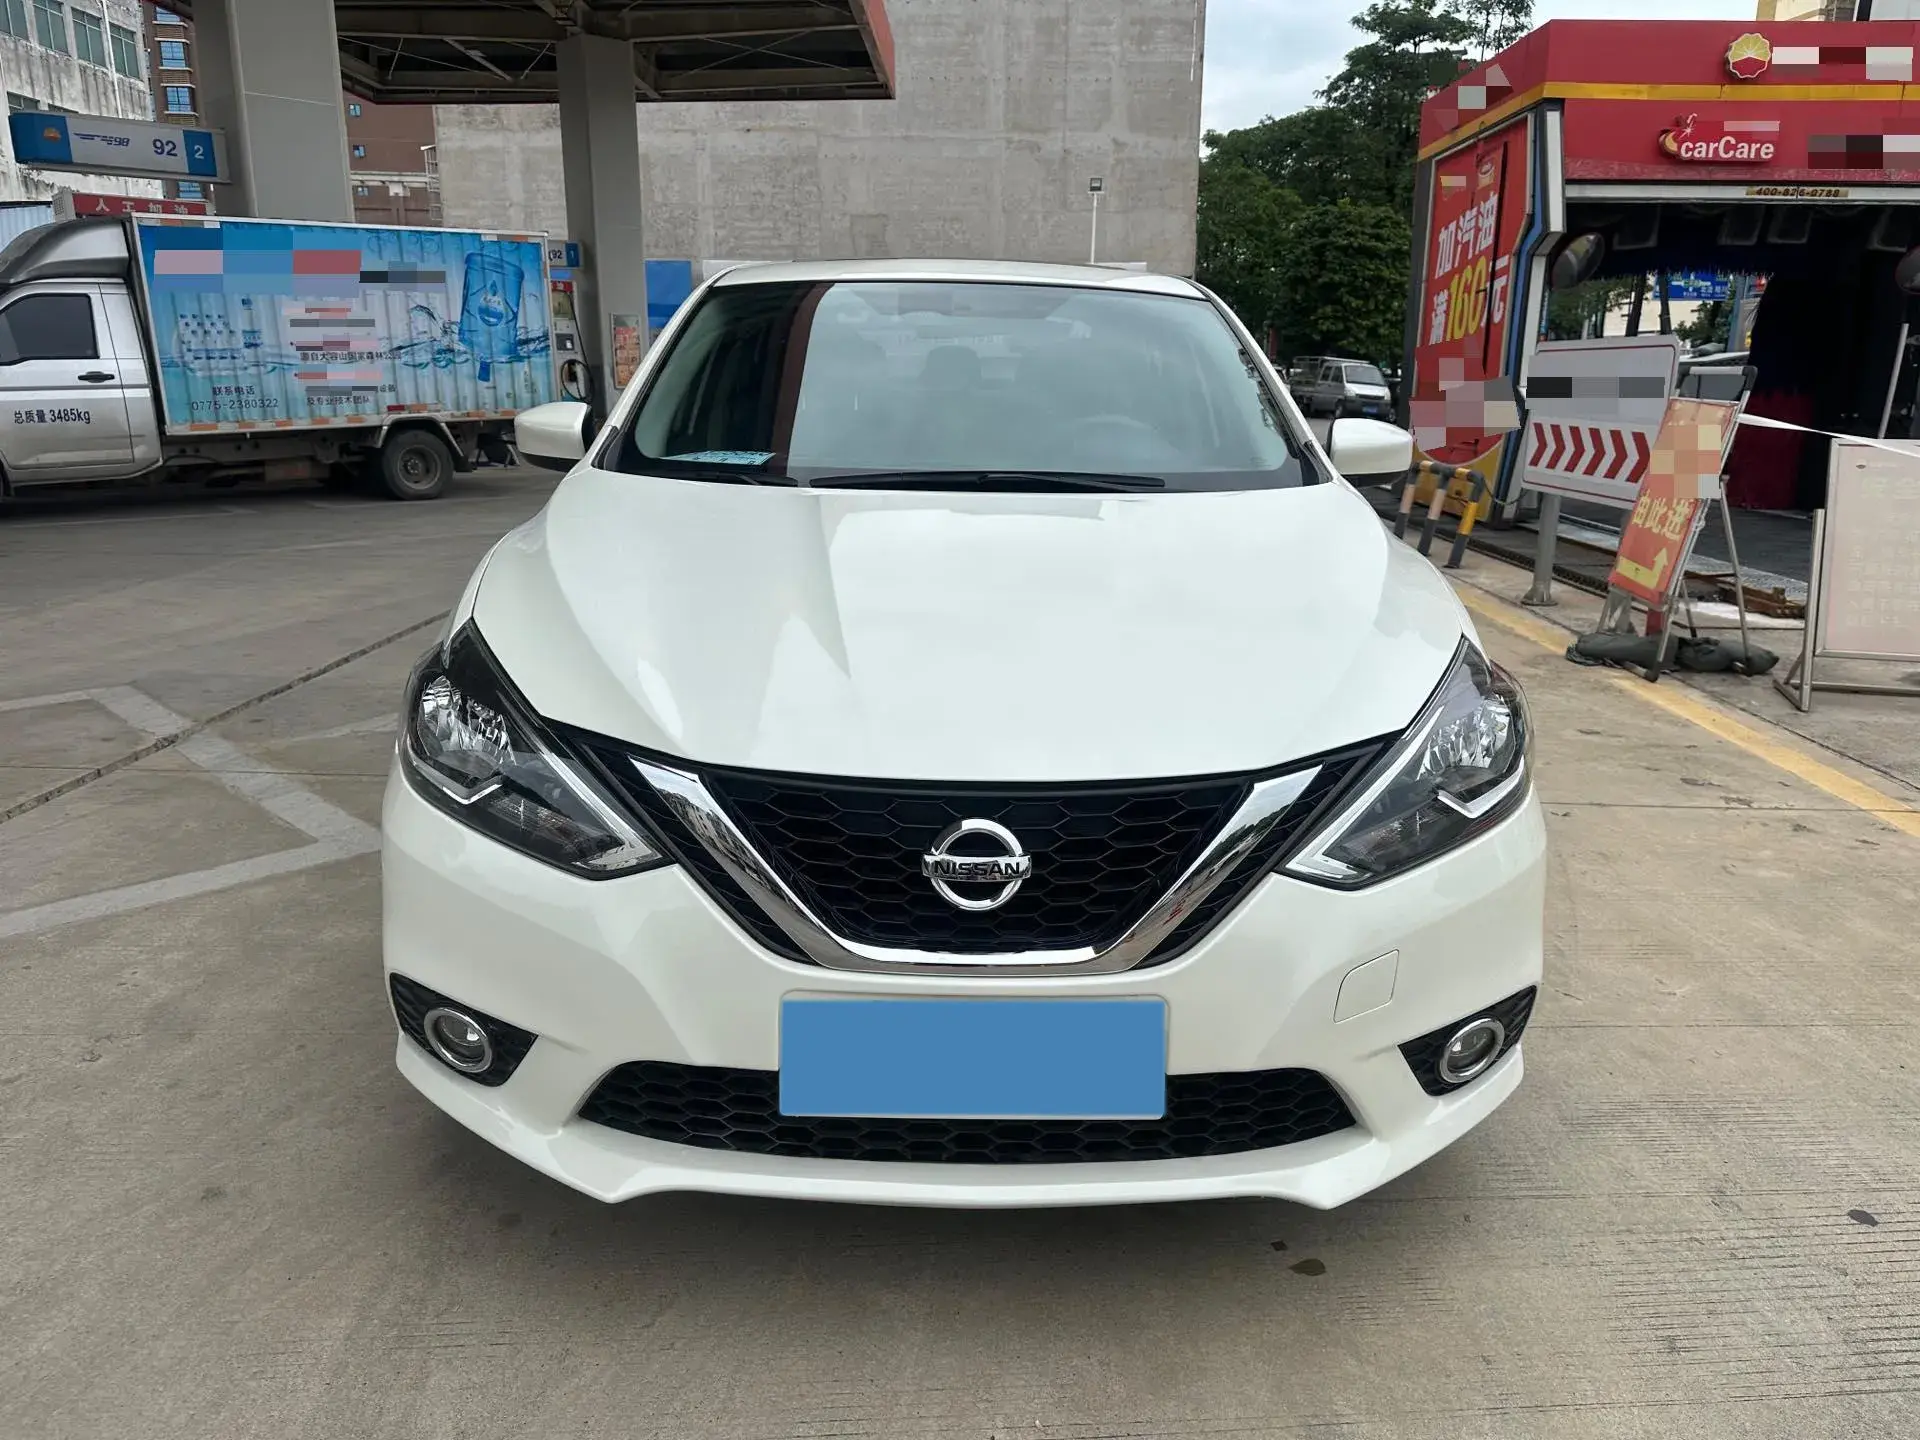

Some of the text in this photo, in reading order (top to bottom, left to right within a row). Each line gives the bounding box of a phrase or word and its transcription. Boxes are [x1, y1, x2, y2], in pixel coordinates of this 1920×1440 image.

[152, 138, 178, 157] 92
[193, 145, 205, 160] 2
[1680, 135, 1774, 160] carCare
[95, 198, 188, 214] 人工加油
[1435, 191, 1499, 279] 加汽油
[212, 385, 255, 396] 联系电话
[191, 398, 279, 411] 0775-2380322
[14, 408, 91, 424] 总质量 3485kg
[1632, 489, 1693, 541] 由此进
[933, 859, 1020, 876] NISSAN
